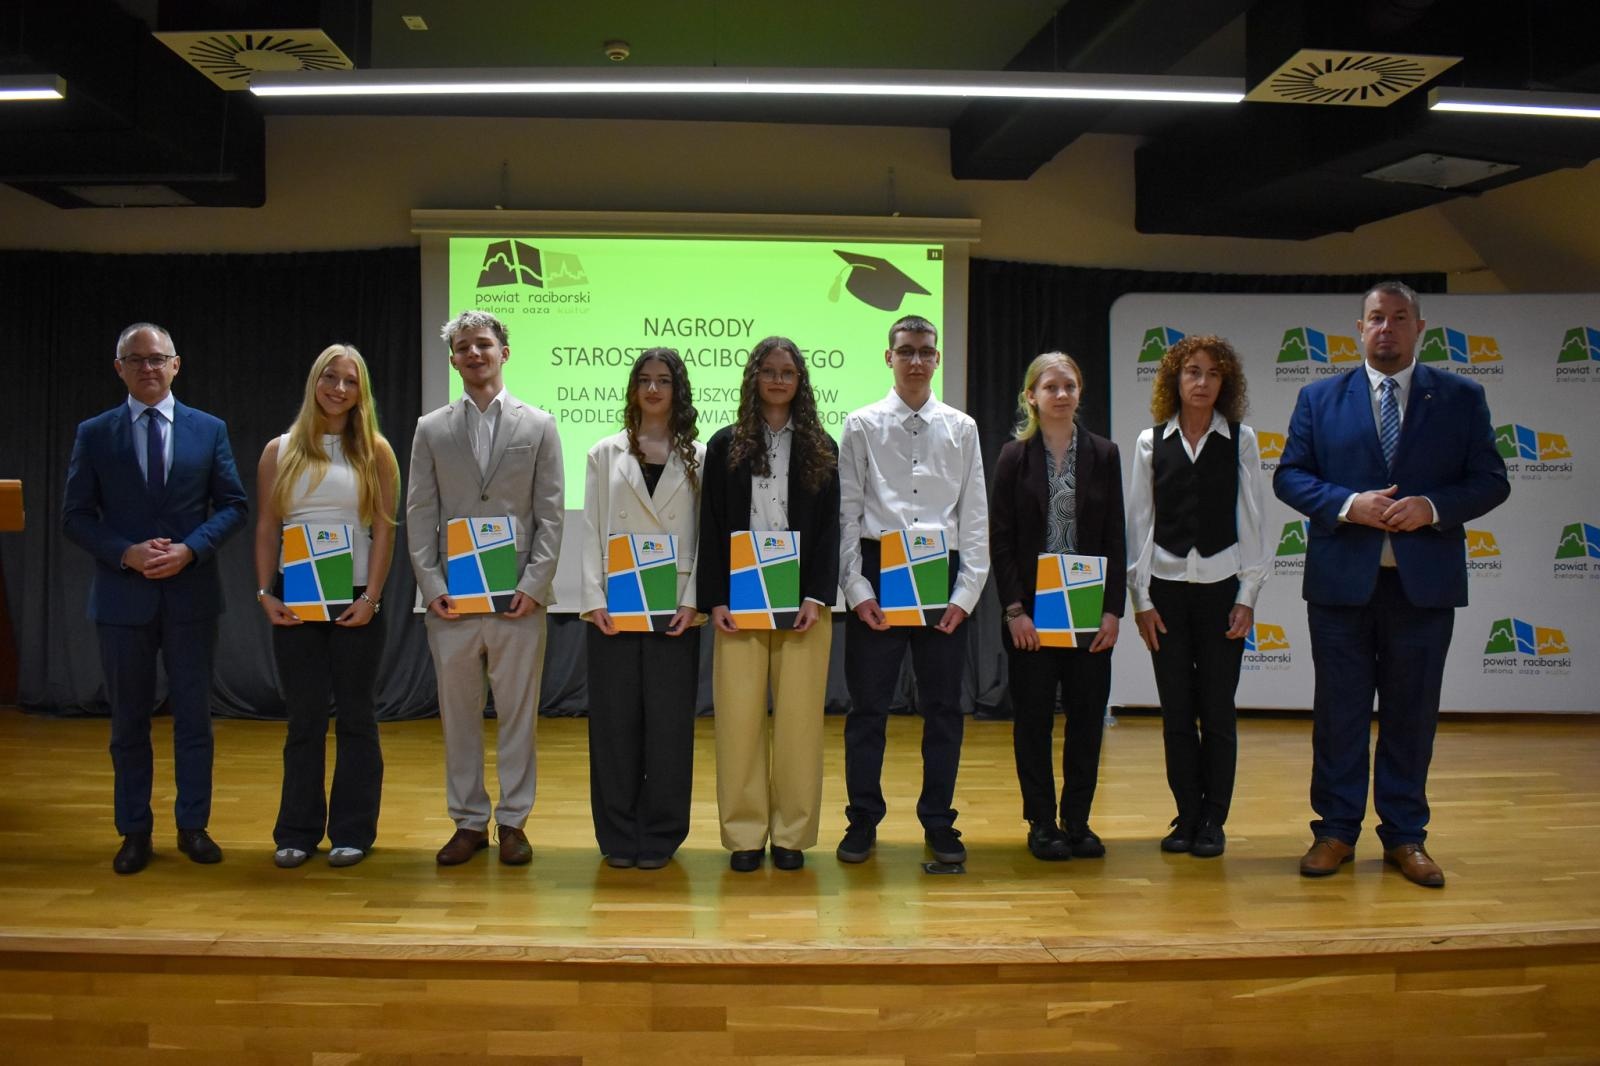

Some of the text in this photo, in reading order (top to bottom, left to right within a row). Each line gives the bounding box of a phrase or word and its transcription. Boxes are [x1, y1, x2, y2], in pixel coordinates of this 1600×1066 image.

[475, 291, 590, 305] powiat raciborski
[522, 306, 550, 314] oaza
[644, 317, 754, 337] NAGRODY
[551, 346, 649, 366] STAROST
[1275, 365, 1310, 376] powiat
[1456, 364, 1504, 375] raciborski
[1556, 366, 1590, 376] powiat
[557, 386, 590, 401] DLA
[1525, 462, 1573, 472] raciborski
[1274, 557, 1304, 569] powia
[1553, 562, 1588, 574] powiat
[1243, 653, 1291, 663] raciborski
[1483, 656, 1571, 667] powiat raciborski
